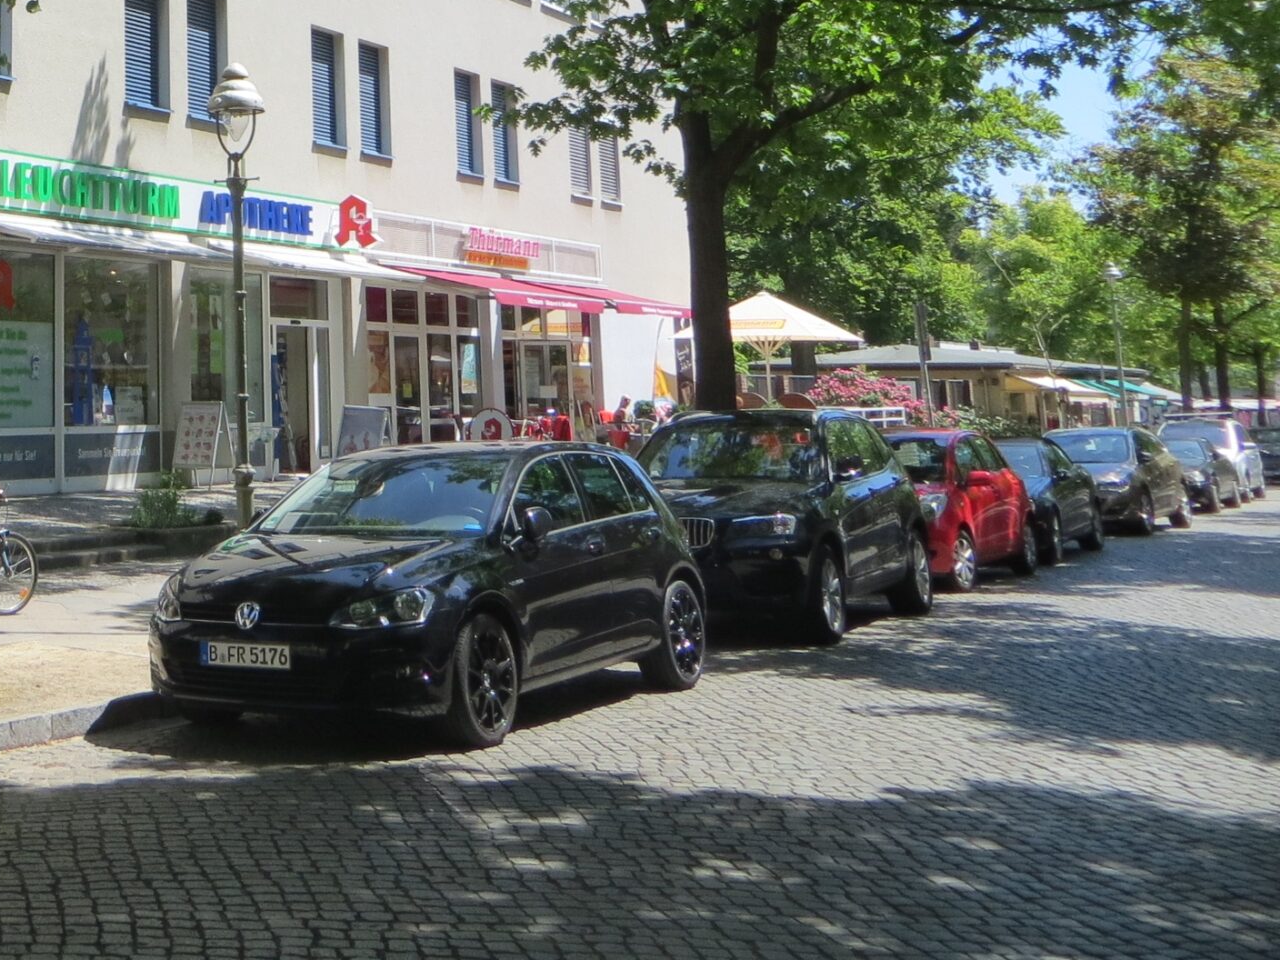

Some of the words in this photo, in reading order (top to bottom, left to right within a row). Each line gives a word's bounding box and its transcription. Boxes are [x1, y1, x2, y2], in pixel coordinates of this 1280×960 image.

[199, 191, 313, 235] APTHEKE
[209, 645, 218, 662] B
[228, 646, 246, 663] FR
[250, 647, 288, 666] 5176
